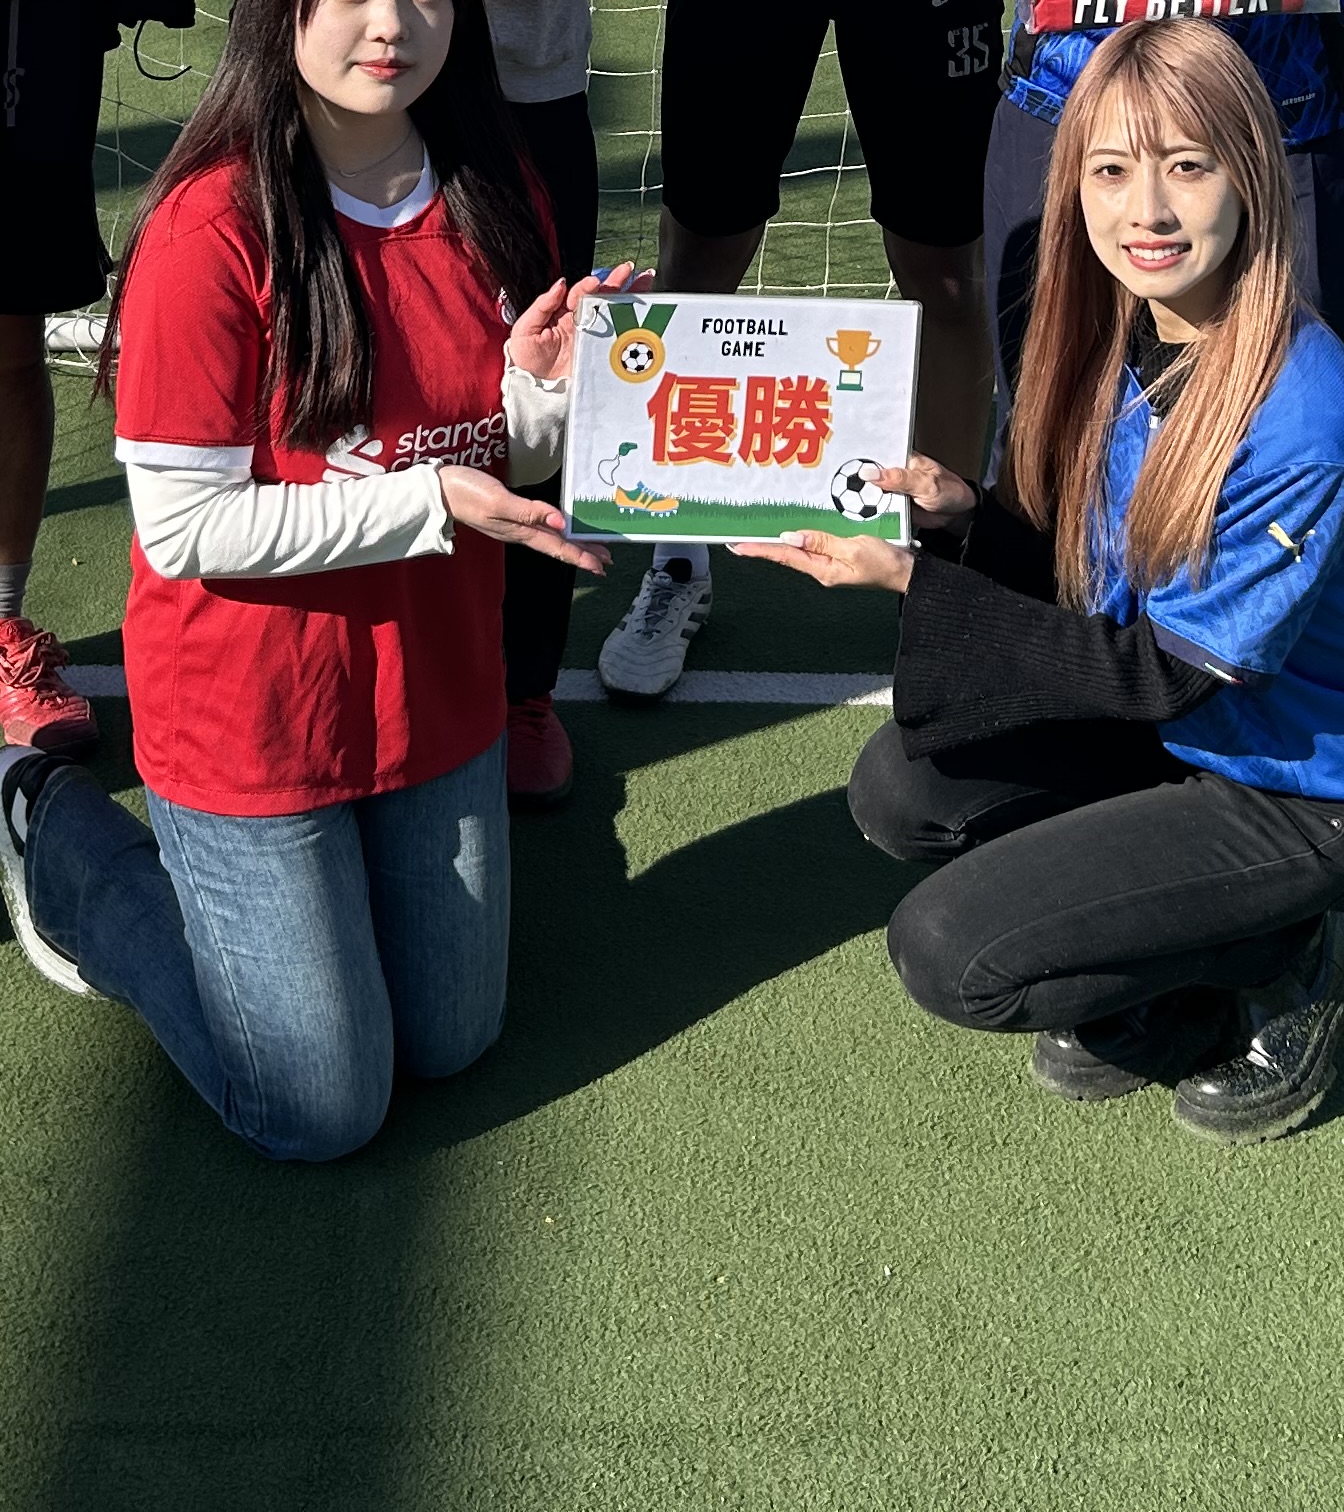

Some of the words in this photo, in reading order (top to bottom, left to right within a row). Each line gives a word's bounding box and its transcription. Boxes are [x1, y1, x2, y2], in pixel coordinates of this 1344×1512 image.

[947, 23, 990, 77] 35
[701, 317, 789, 337] FOOTBALL
[721, 341, 766, 358] GAME
[647, 371, 833, 467] 優勝
